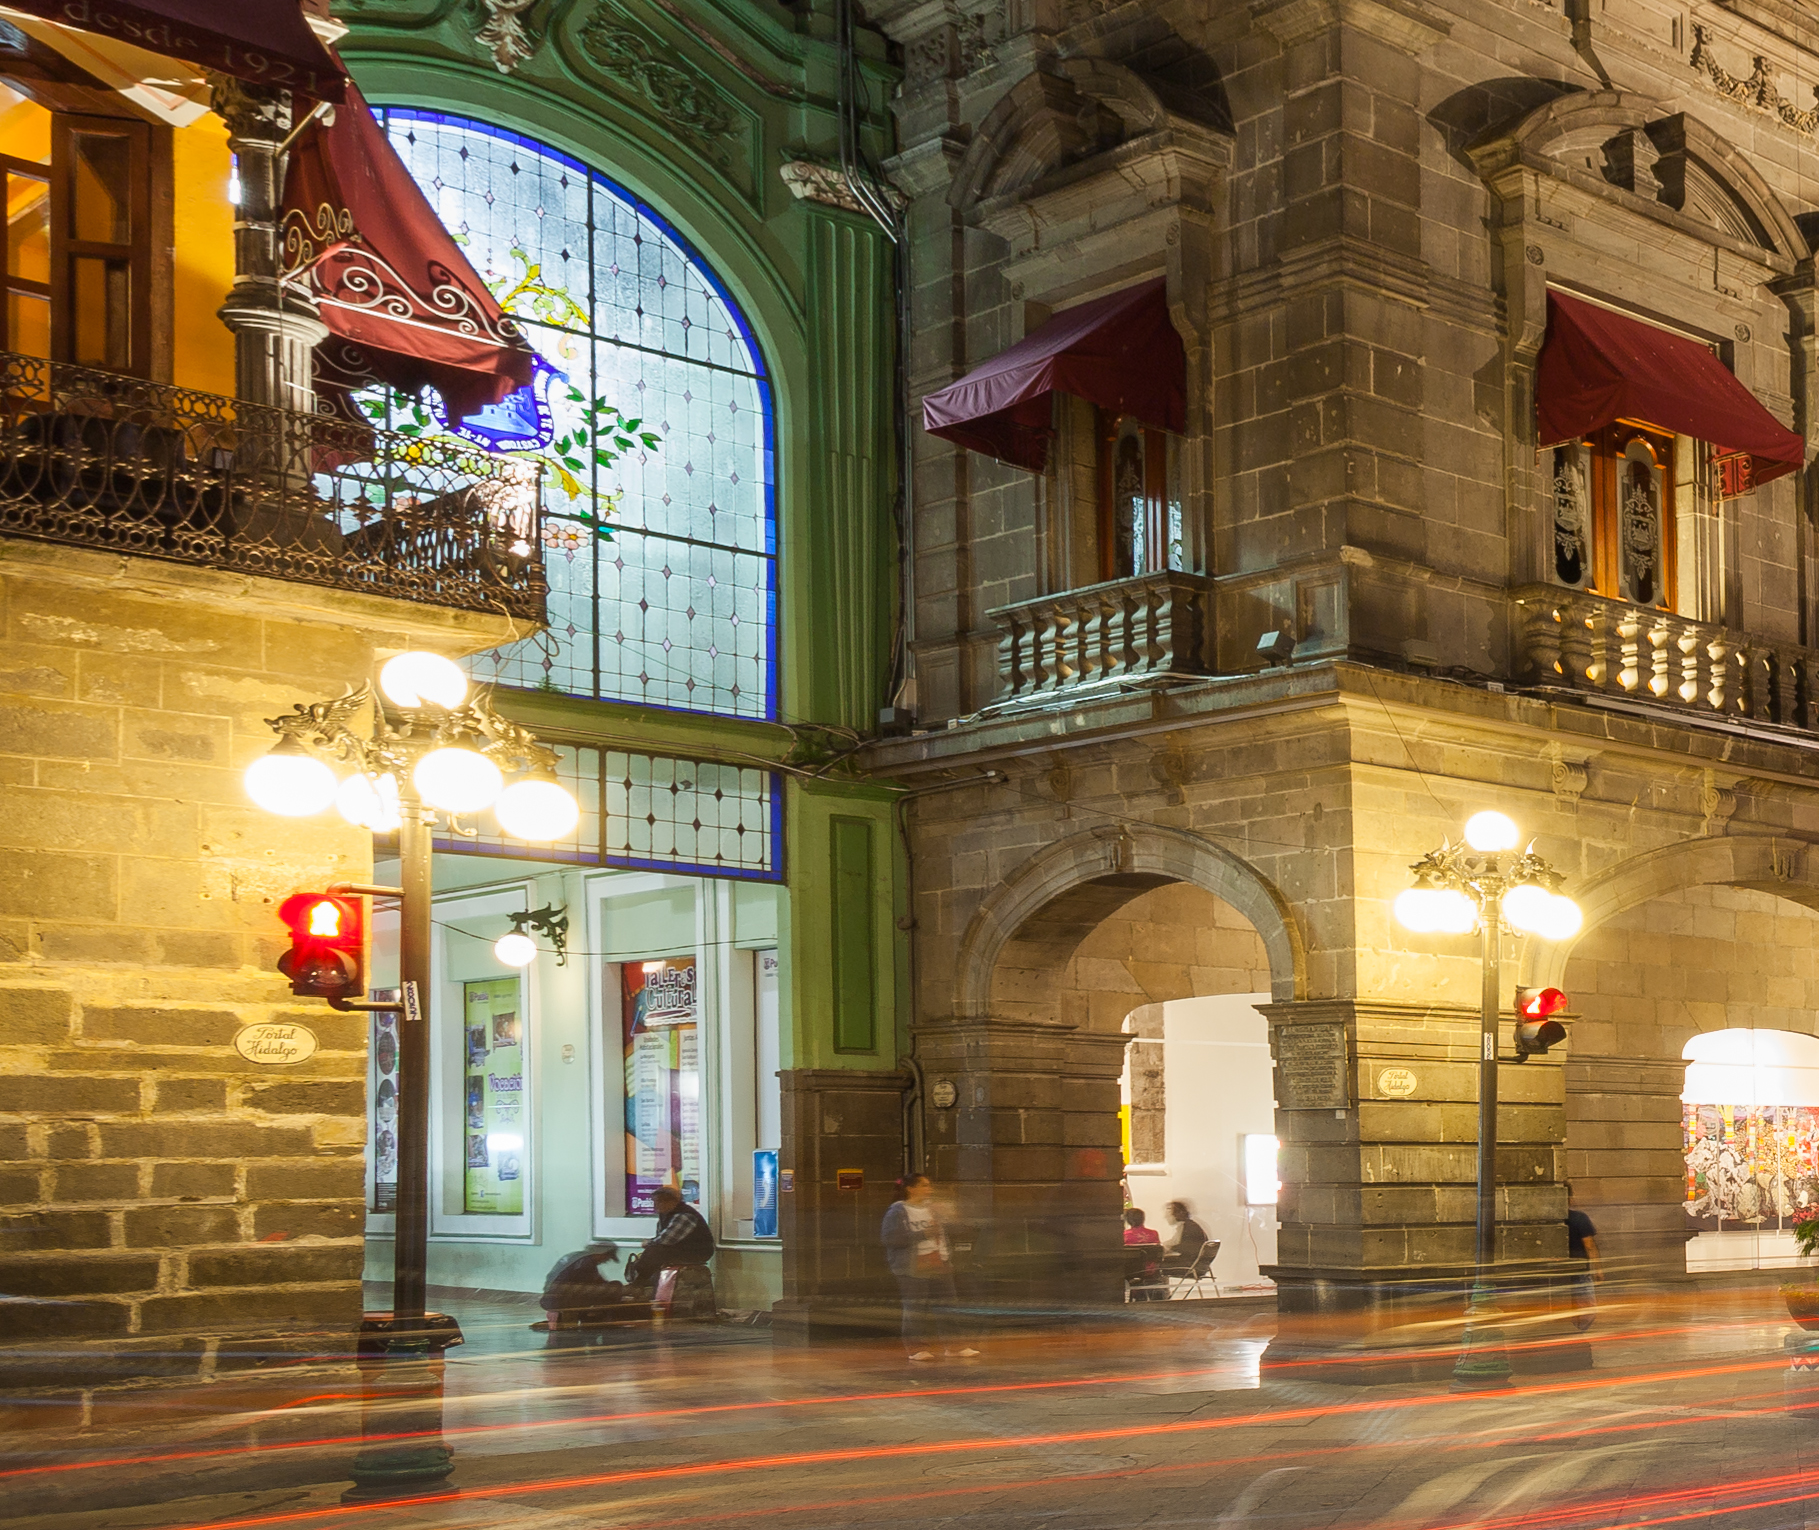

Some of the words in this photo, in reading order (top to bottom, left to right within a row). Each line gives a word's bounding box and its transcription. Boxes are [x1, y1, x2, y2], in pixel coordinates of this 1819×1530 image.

[64, 0, 198, 49] desde
[225, 44, 320, 95] 1921
[254, 1027, 296, 1039] Portal
[244, 1040, 298, 1062] Hidalgo
